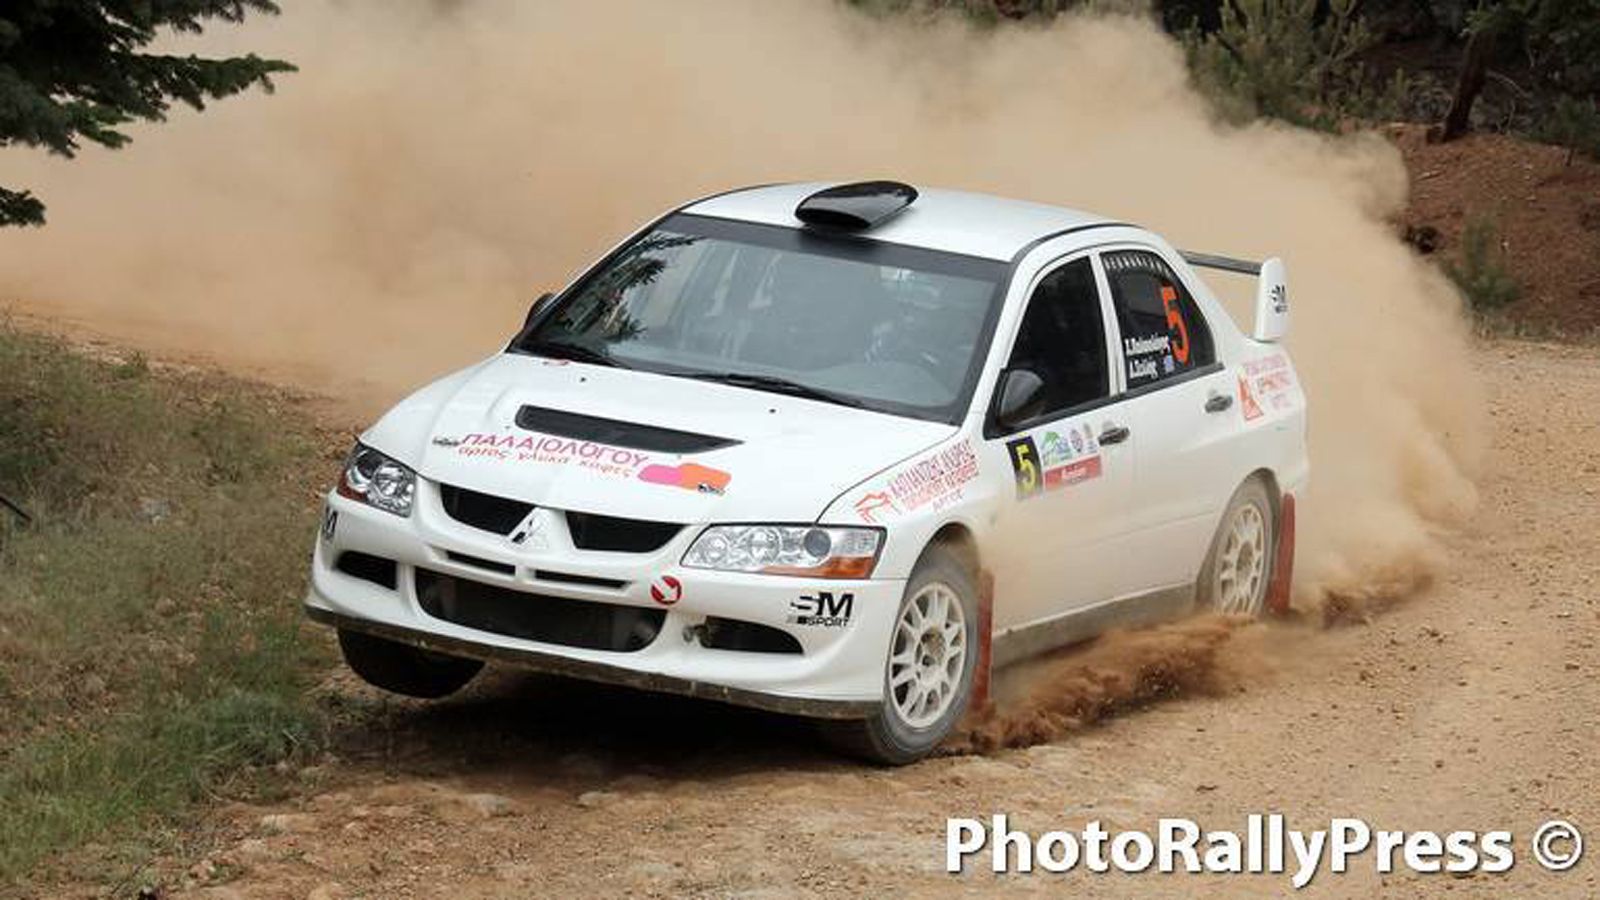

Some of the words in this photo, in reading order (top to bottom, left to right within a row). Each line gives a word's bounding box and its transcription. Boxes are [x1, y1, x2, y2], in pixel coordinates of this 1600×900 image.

[1161, 285, 1191, 366] 5
[461, 433, 649, 467] ΠΑΛΑΙΟΛΟΓΟΥ
[1015, 444, 1037, 494] 5
